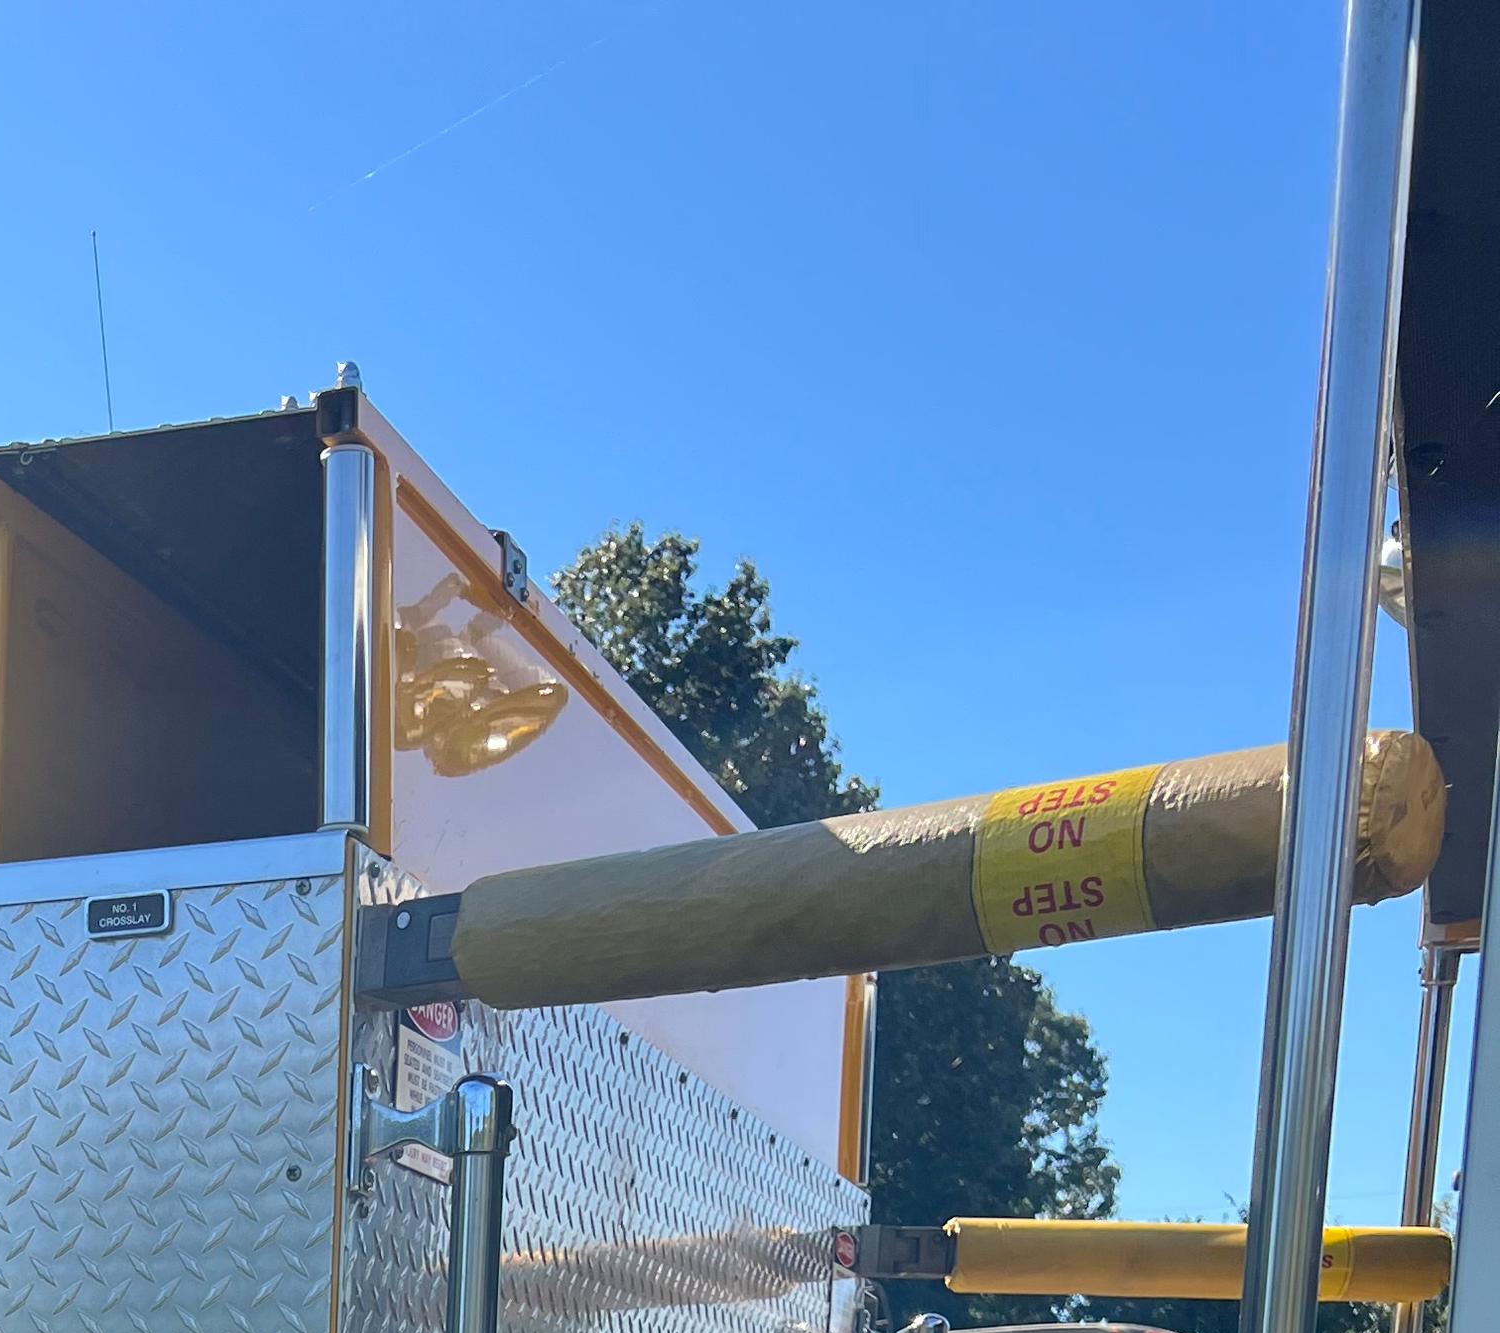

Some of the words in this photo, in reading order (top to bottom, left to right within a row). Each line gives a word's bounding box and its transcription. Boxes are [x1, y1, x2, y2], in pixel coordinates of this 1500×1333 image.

[1018, 780, 1117, 816] STEP
[1028, 816, 1086, 854] NO
[131, 902, 137, 911] 1
[1012, 876, 1105, 917] STEP
[98, 913, 152, 928] CROSSLAY
[1038, 918, 1096, 947] NO
[411, 1002, 453, 1033] ANGER
